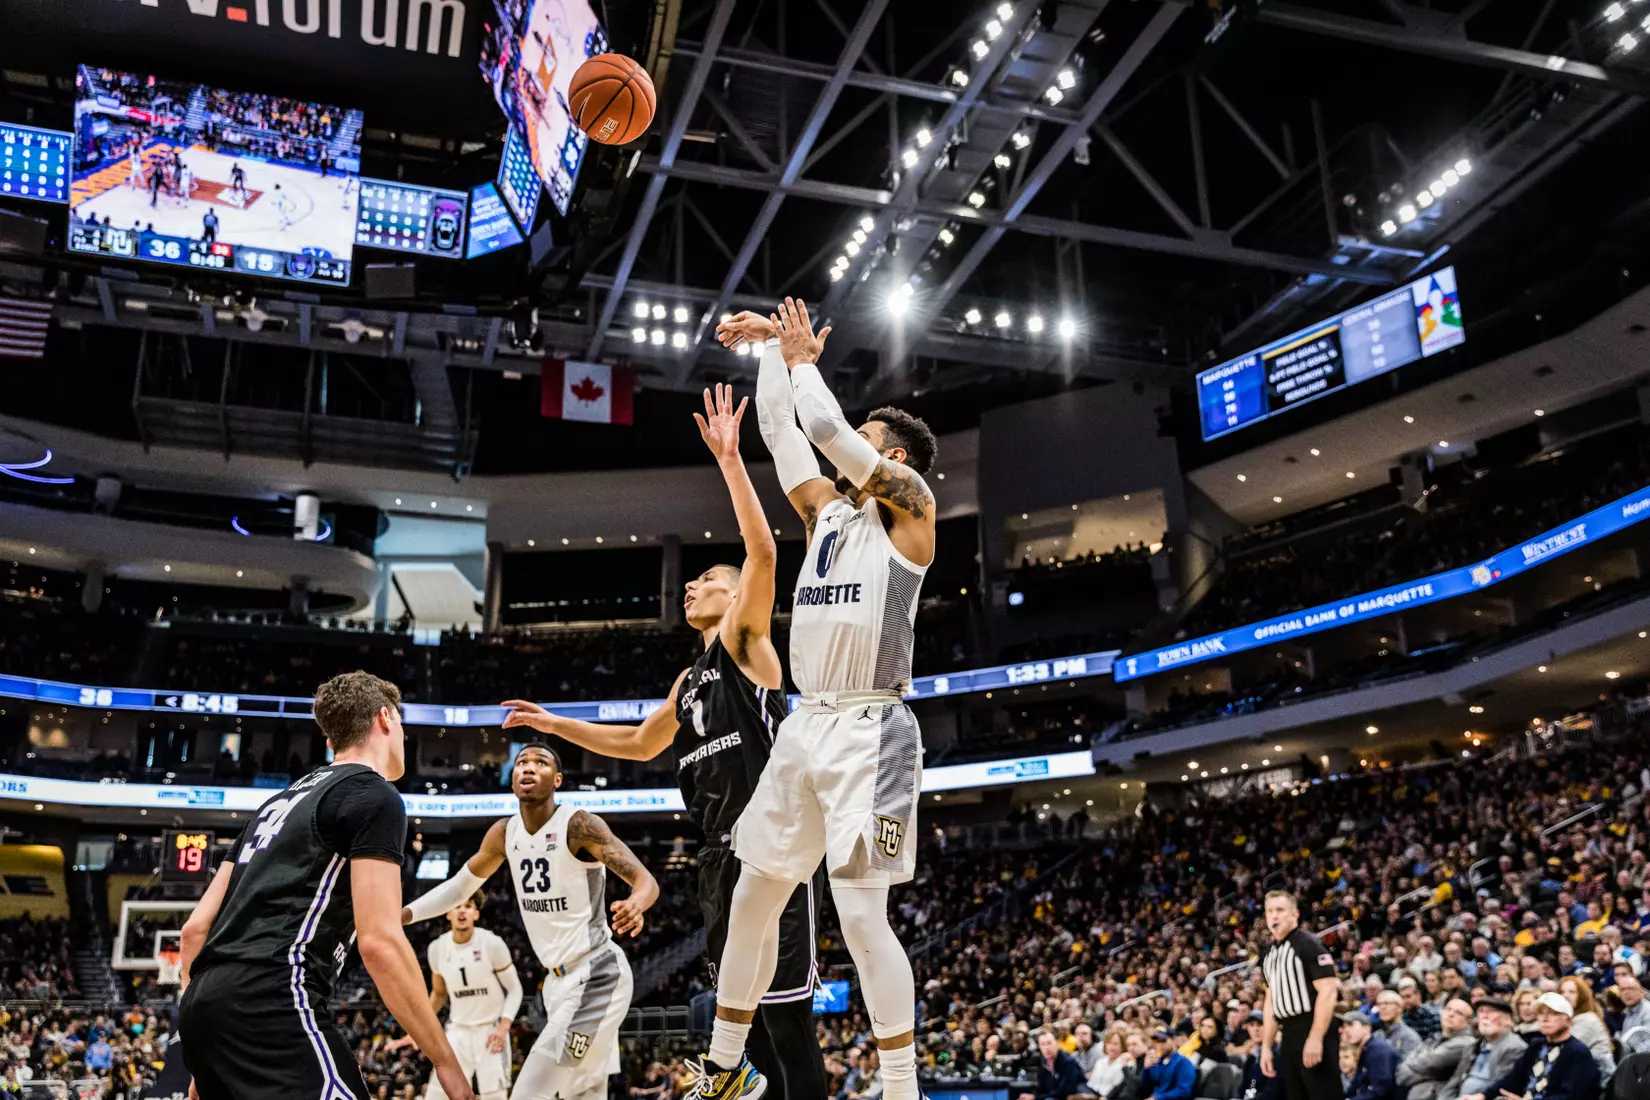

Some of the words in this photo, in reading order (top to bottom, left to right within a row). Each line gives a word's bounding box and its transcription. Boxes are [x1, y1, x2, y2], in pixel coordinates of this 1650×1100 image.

[149, 239, 181, 259] 36
[190, 252, 225, 268] 8:45
[243, 251, 273, 271] 15
[1202, 356, 1256, 386] MARQUETTE
[816, 529, 839, 578] 0
[1254, 621, 1304, 639] OFFICIAL
[1305, 609, 1337, 627] BANK
[1339, 604, 1355, 617] OF
[1358, 583, 1434, 613] MARQUETTE
[1156, 645, 1190, 665] TOWN
[1192, 636, 1226, 657] BANK
[1006, 663, 1049, 683] 1:33
[1053, 657, 1086, 677] PM
[79, 688, 113, 706] 36
[181, 693, 239, 714] 8:45
[444, 708, 469, 724] 15
[176, 834, 207, 849] 8:45
[877, 816, 902, 858] MU
[179, 848, 202, 871] 19
[520, 858, 551, 893] 23
[459, 967, 468, 986] 1
[569, 1032, 589, 1059] MU
